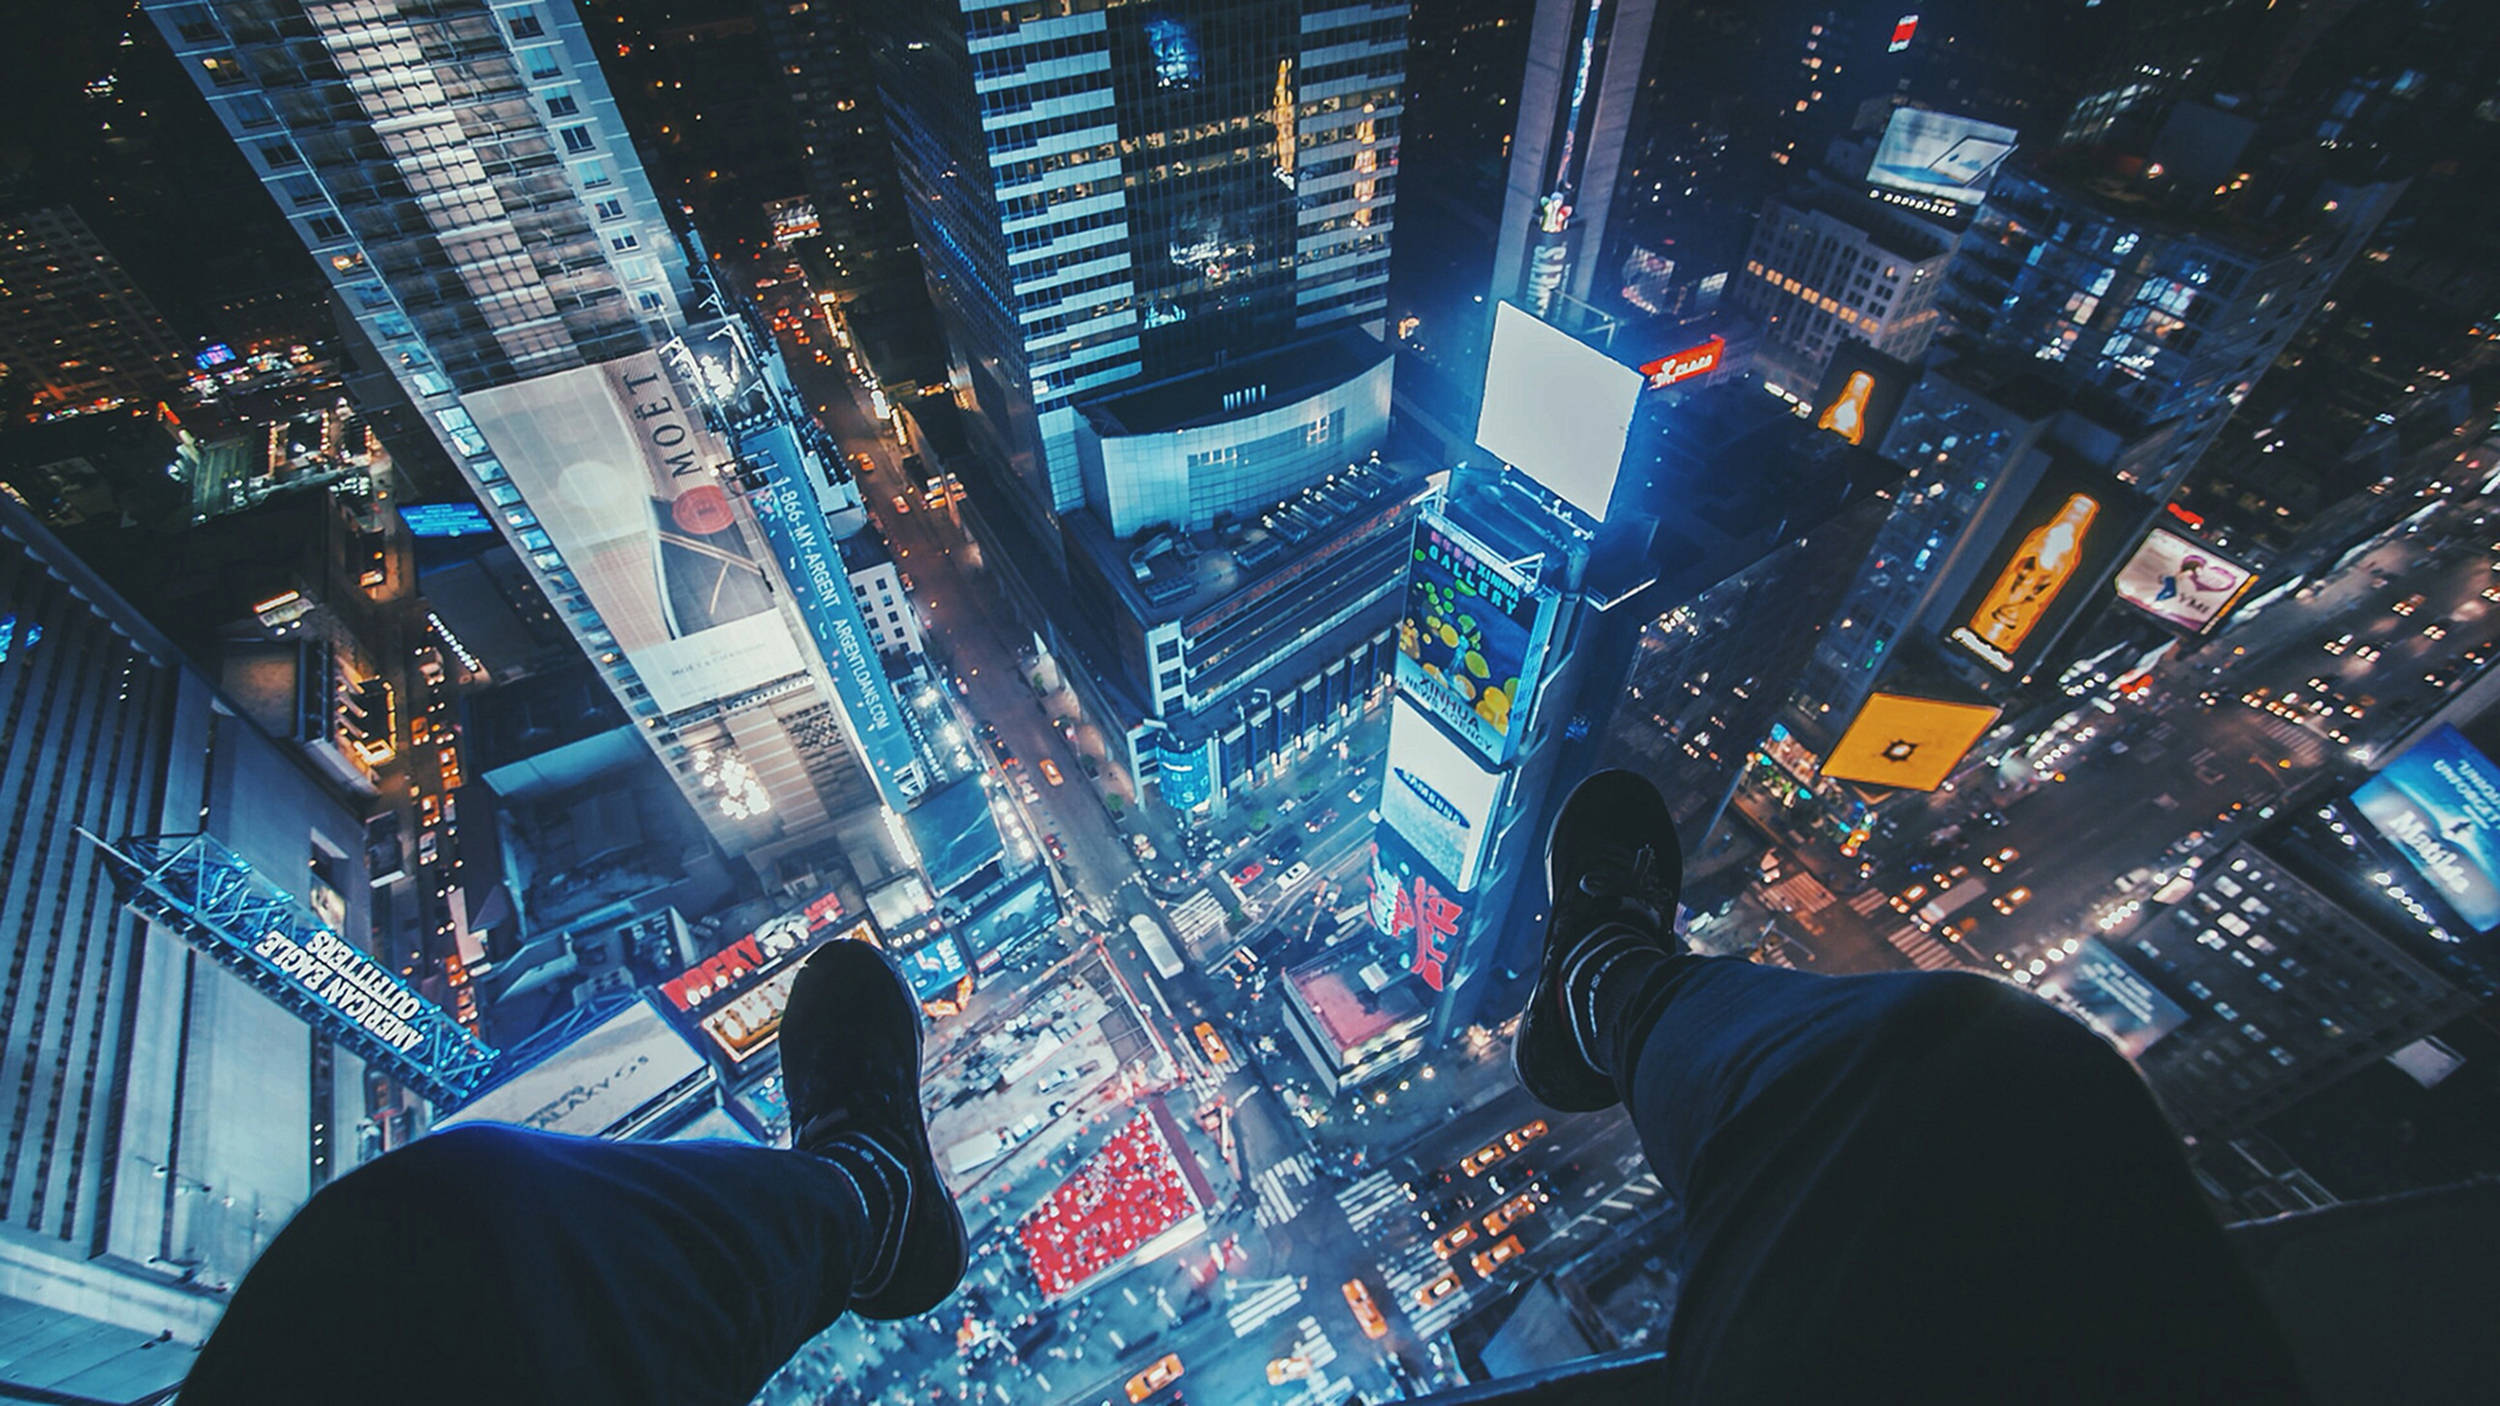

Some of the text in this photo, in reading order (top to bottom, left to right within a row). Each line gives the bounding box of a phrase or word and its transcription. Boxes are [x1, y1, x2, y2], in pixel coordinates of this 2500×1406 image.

[622, 371, 702, 479] MOËT
[1428, 545, 1517, 615] GALLERY
[832, 618, 891, 731] ARGENTLOANS.COM
[1420, 674, 1481, 733] XINHUA
[1400, 770, 1463, 826] SAMSUNG
[255, 930, 425, 1054] AMERICAN EAGLE
[305, 930, 421, 1020] OUTFITTERS
[659, 933, 764, 1013] ROCKY
